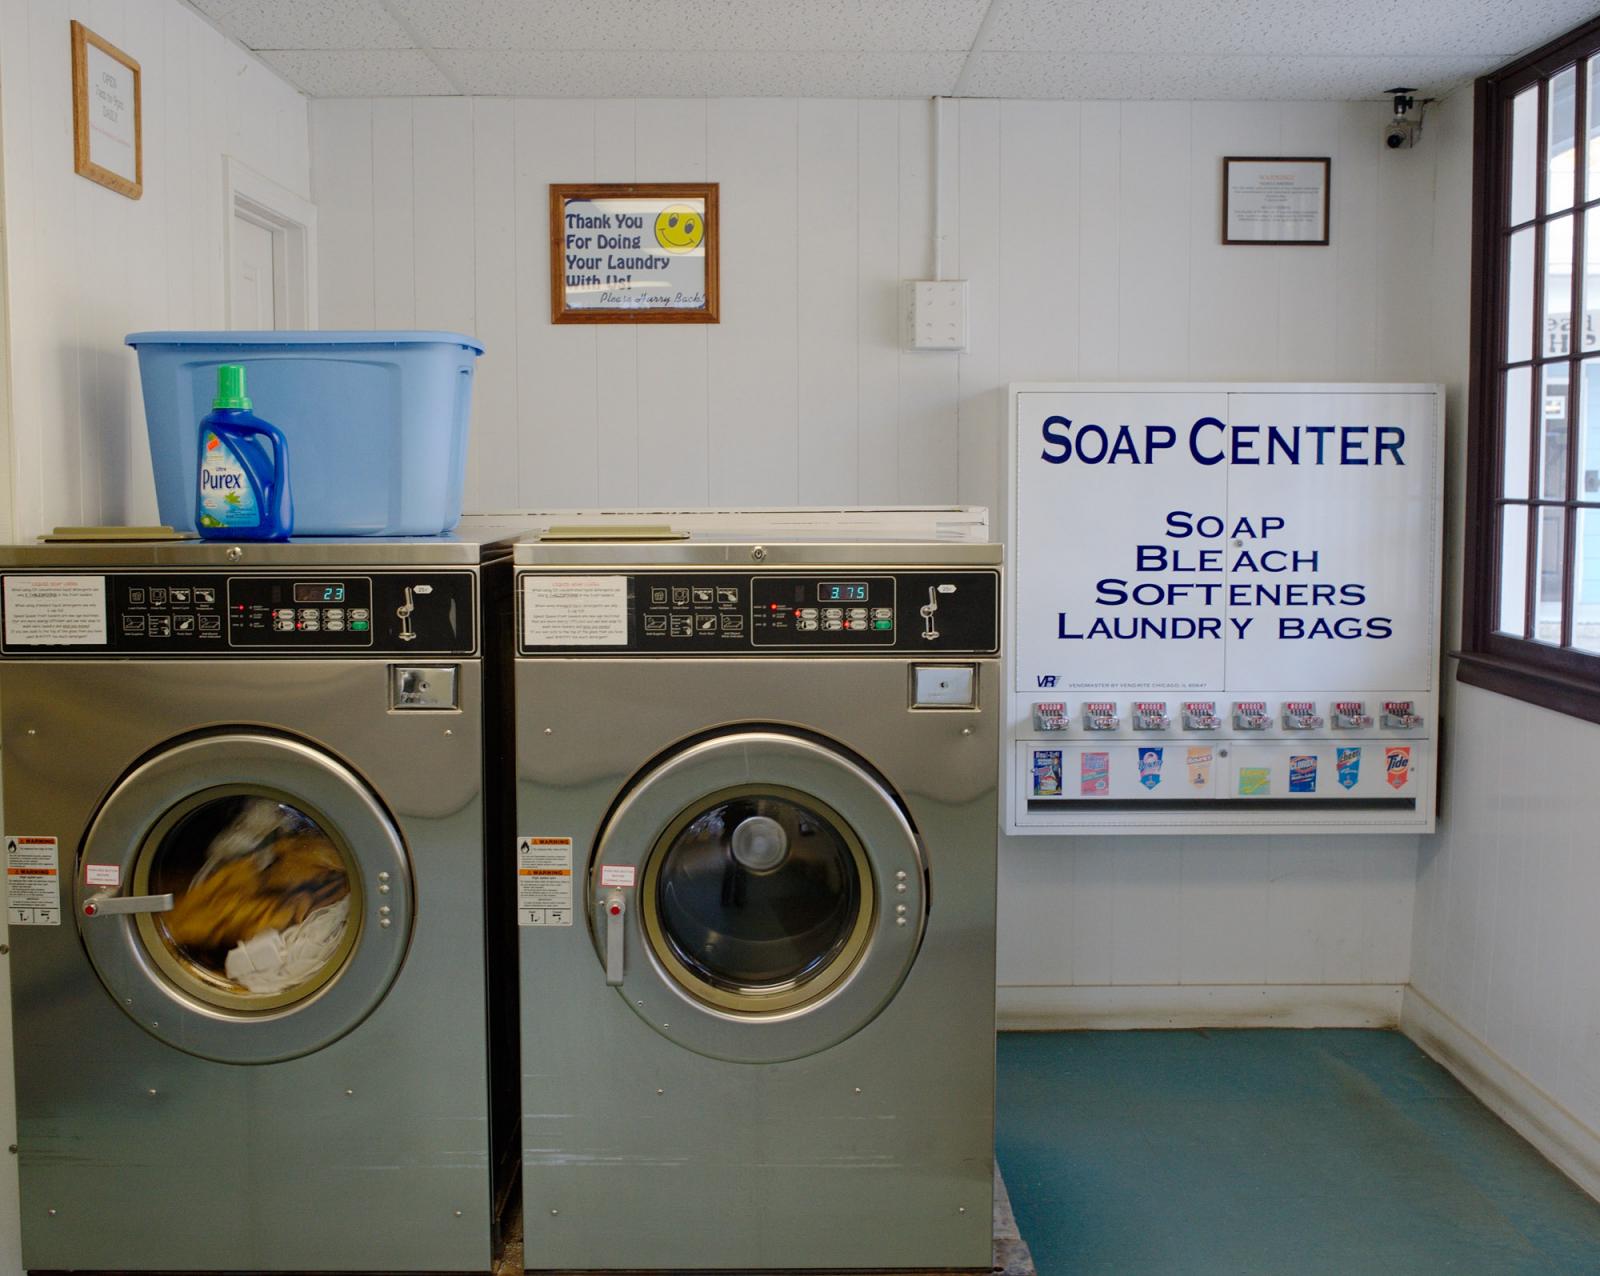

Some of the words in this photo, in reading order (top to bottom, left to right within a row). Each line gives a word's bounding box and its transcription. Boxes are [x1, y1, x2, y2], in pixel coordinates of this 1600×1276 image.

[565, 213, 612, 229] Thank
[615, 213, 643, 229] You
[566, 234, 592, 249] For
[597, 234, 641, 250] Doing
[566, 254, 602, 270] Your
[607, 254, 670, 270] Laundry
[566, 274, 601, 289] With
[606, 274, 632, 290] Us!
[1041, 415, 1177, 465] SOAP
[1189, 416, 1407, 466] CENTER
[202, 469, 242, 490] Purex
[1165, 510, 1285, 538] SOAP
[1135, 545, 1319, 572] BLEACH
[323, 587, 344, 600] 23
[1095, 578, 1366, 606] SOFTENERS
[1058, 612, 1254, 639] LAUNDRY
[1278, 617, 1393, 639] BAGS
[1386, 753, 1409, 772] Tide
